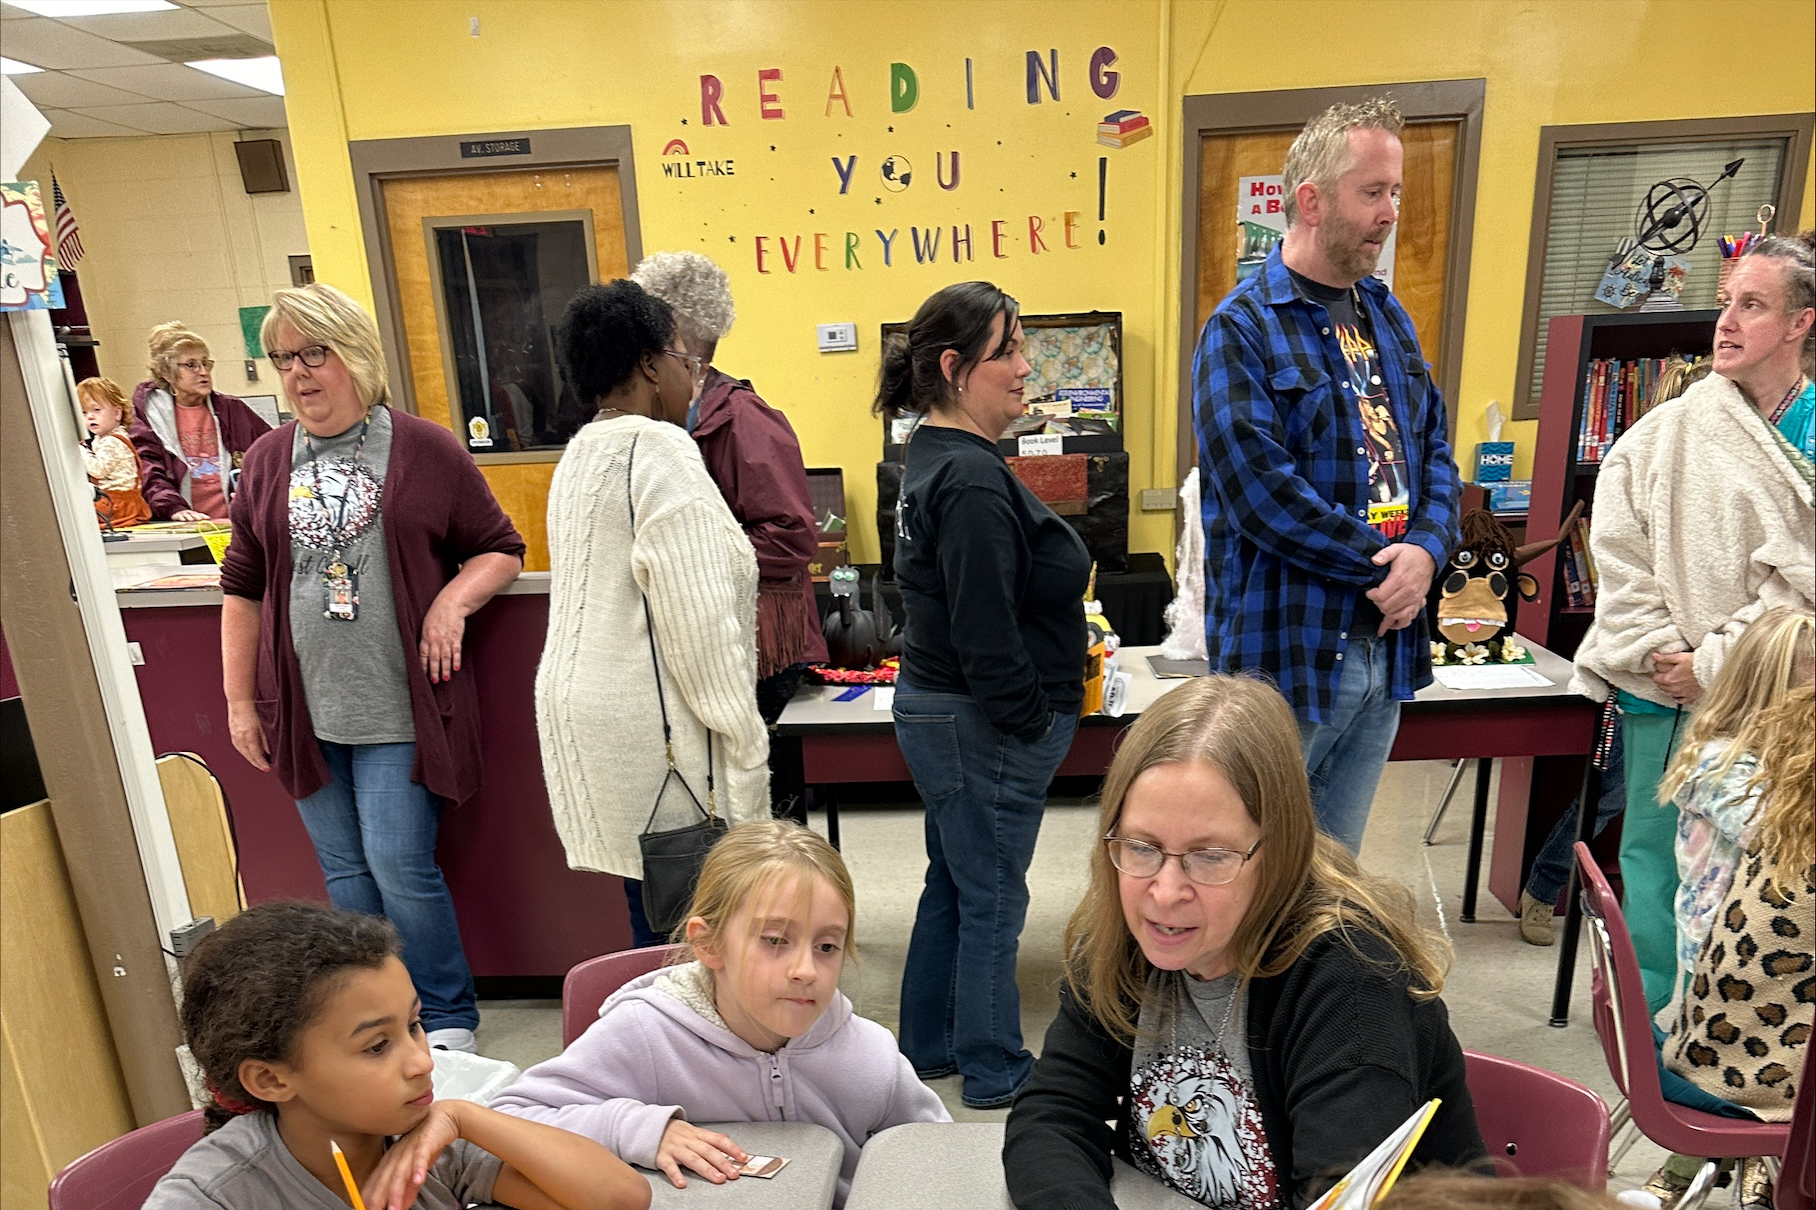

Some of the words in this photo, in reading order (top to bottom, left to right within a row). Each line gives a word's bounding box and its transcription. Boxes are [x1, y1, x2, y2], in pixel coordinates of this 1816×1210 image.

[699, 45, 1121, 127] READING
[486, 141, 520, 154] STORAGE
[661, 161, 696, 179] WILL
[696, 159, 735, 177] TAKE
[1021, 437, 1038, 445] Book
[1040, 436, 1059, 444] Level
[1480, 454, 1514, 465] HOME
